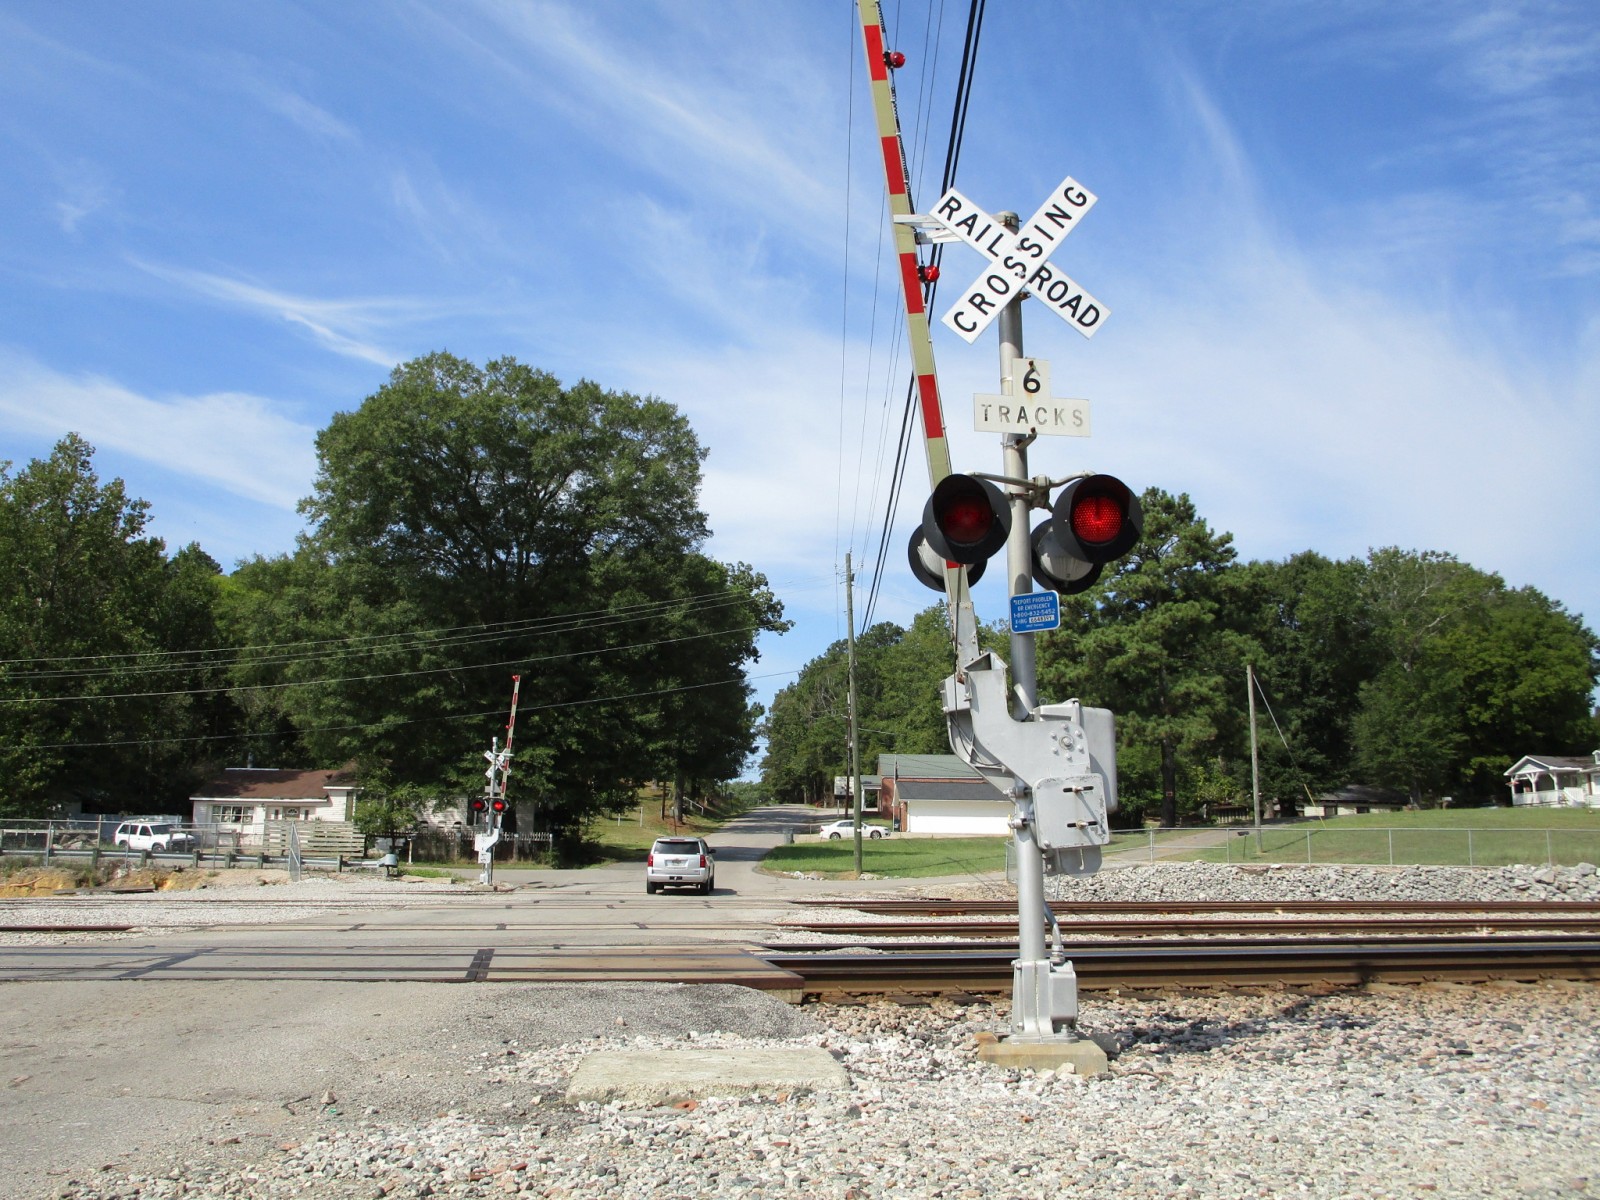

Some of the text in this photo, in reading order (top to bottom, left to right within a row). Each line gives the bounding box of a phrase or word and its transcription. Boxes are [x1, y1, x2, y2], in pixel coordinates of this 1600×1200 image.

[937, 196, 1100, 328] RAIL ROAD
[953, 186, 1087, 333] CROSSING
[980, 403, 1084, 428] TRACKS
[1023, 368, 1041, 394] 6
